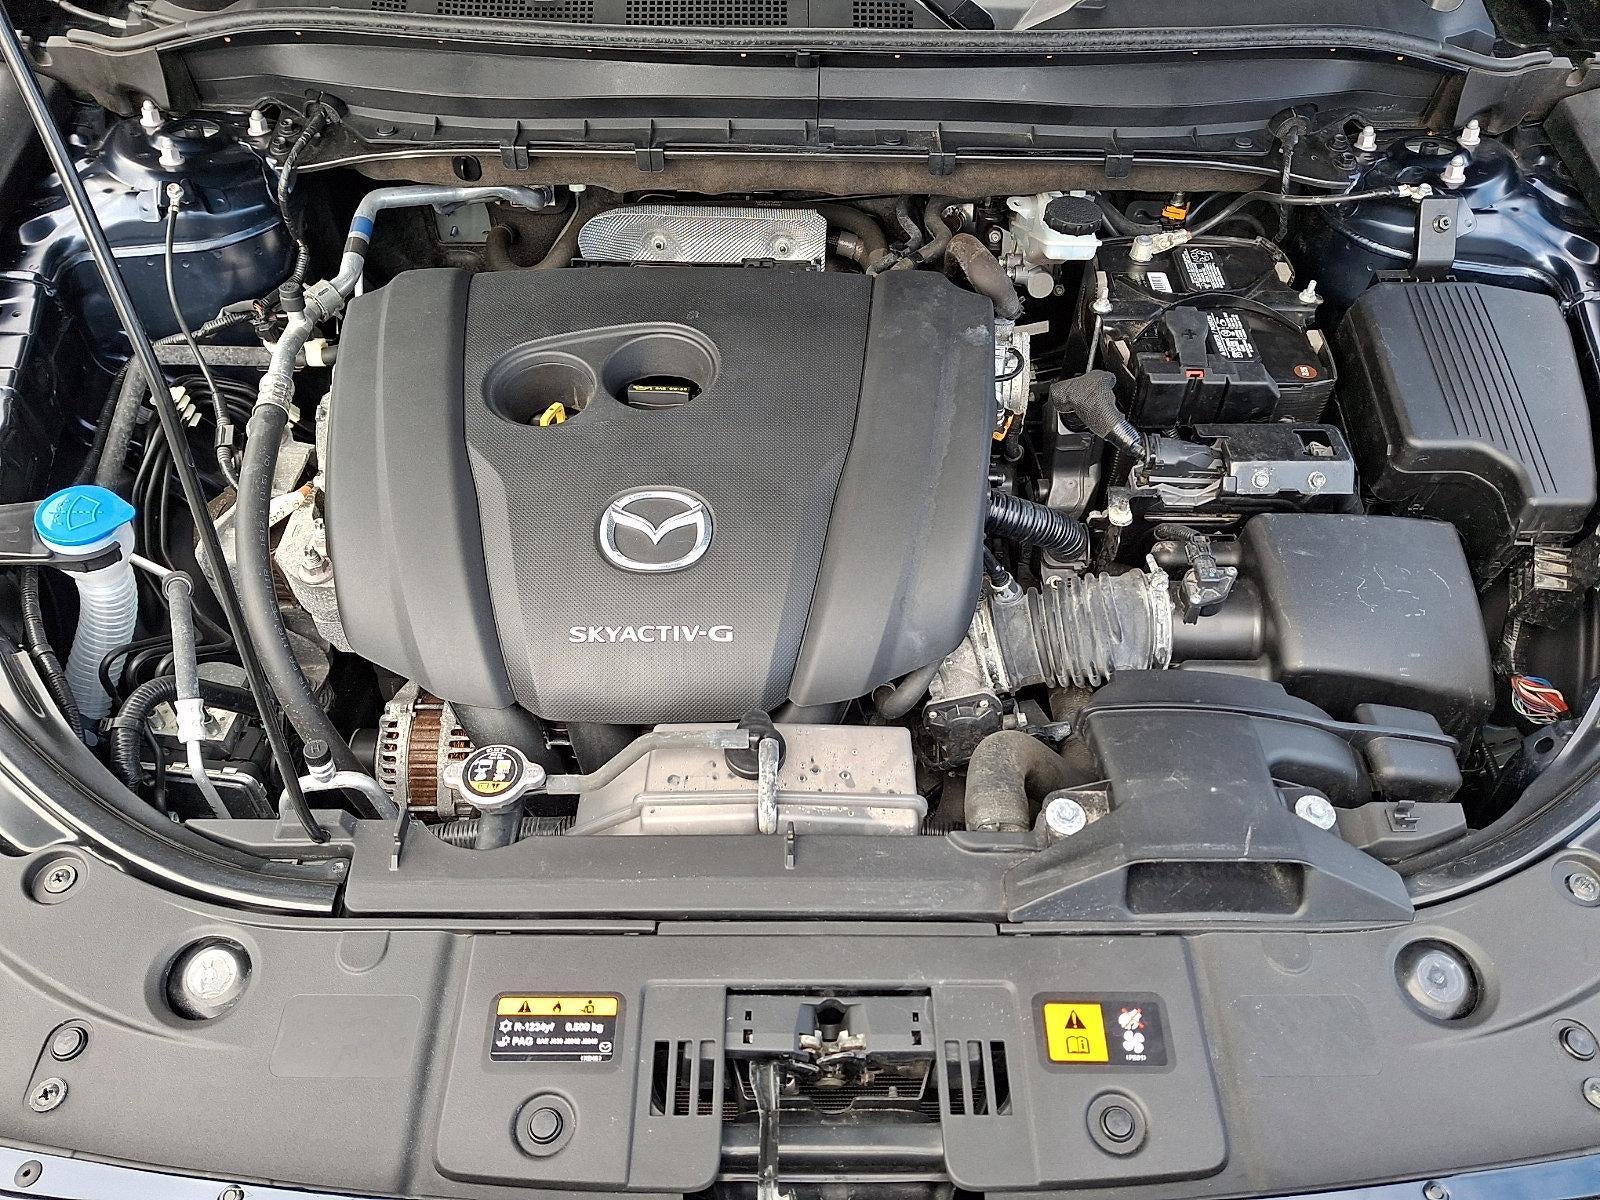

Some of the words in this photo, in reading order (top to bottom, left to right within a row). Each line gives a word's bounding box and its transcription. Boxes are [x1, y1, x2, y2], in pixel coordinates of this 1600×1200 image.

[568, 624, 735, 644] SKYACTIV-G
[310, 743, 321, 753] H
[591, 1021, 605, 1034] kg
[511, 1036, 534, 1047] PAG
